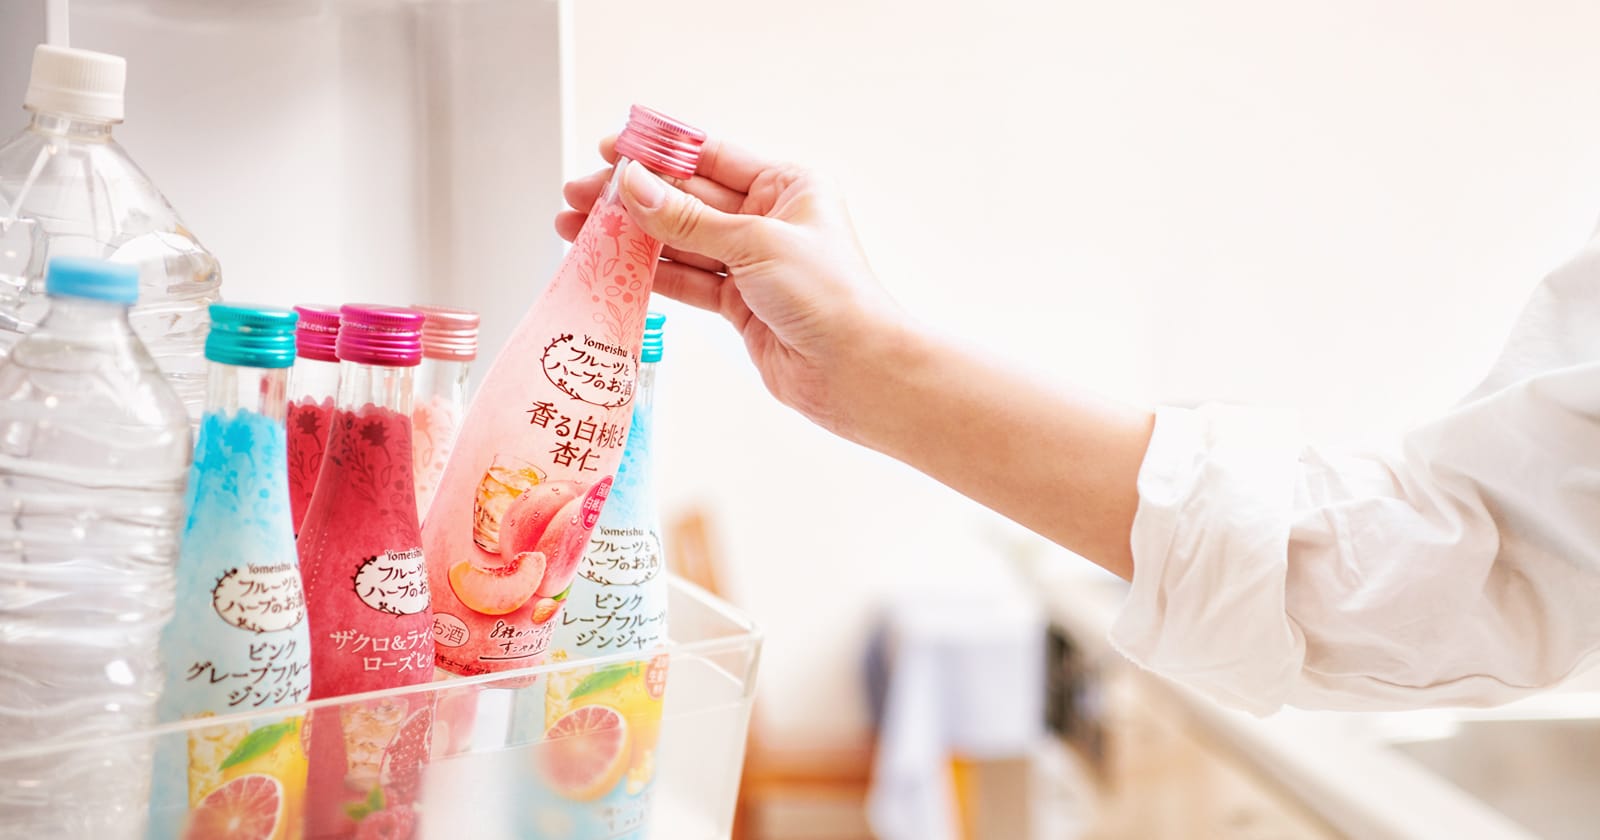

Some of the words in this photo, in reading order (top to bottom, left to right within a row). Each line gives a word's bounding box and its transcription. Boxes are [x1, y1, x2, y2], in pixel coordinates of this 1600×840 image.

[583, 334, 628, 358] Yomeishu
[567, 347, 630, 376] フルーツと
[527, 400, 625, 449] 香る白桃と
[549, 441, 600, 472] 杏仁
[600, 526, 643, 537] Yomeishu
[386, 547, 424, 561] Yomeish
[591, 539, 650, 553] フルーツと
[246, 562, 291, 574] Yomeishu
[378, 563, 427, 583] フルーツ
[239, 576, 299, 596] フルーツと
[596, 593, 643, 611] ピンク
[563, 608, 665, 630] レープフルーツ
[432, 618, 466, 645] お酒
[576, 629, 658, 649] ジンジャー
[249, 640, 297, 661] ピンク
[363, 648, 434, 673] ローズヒッ
[228, 681, 310, 707] ジンジャー
